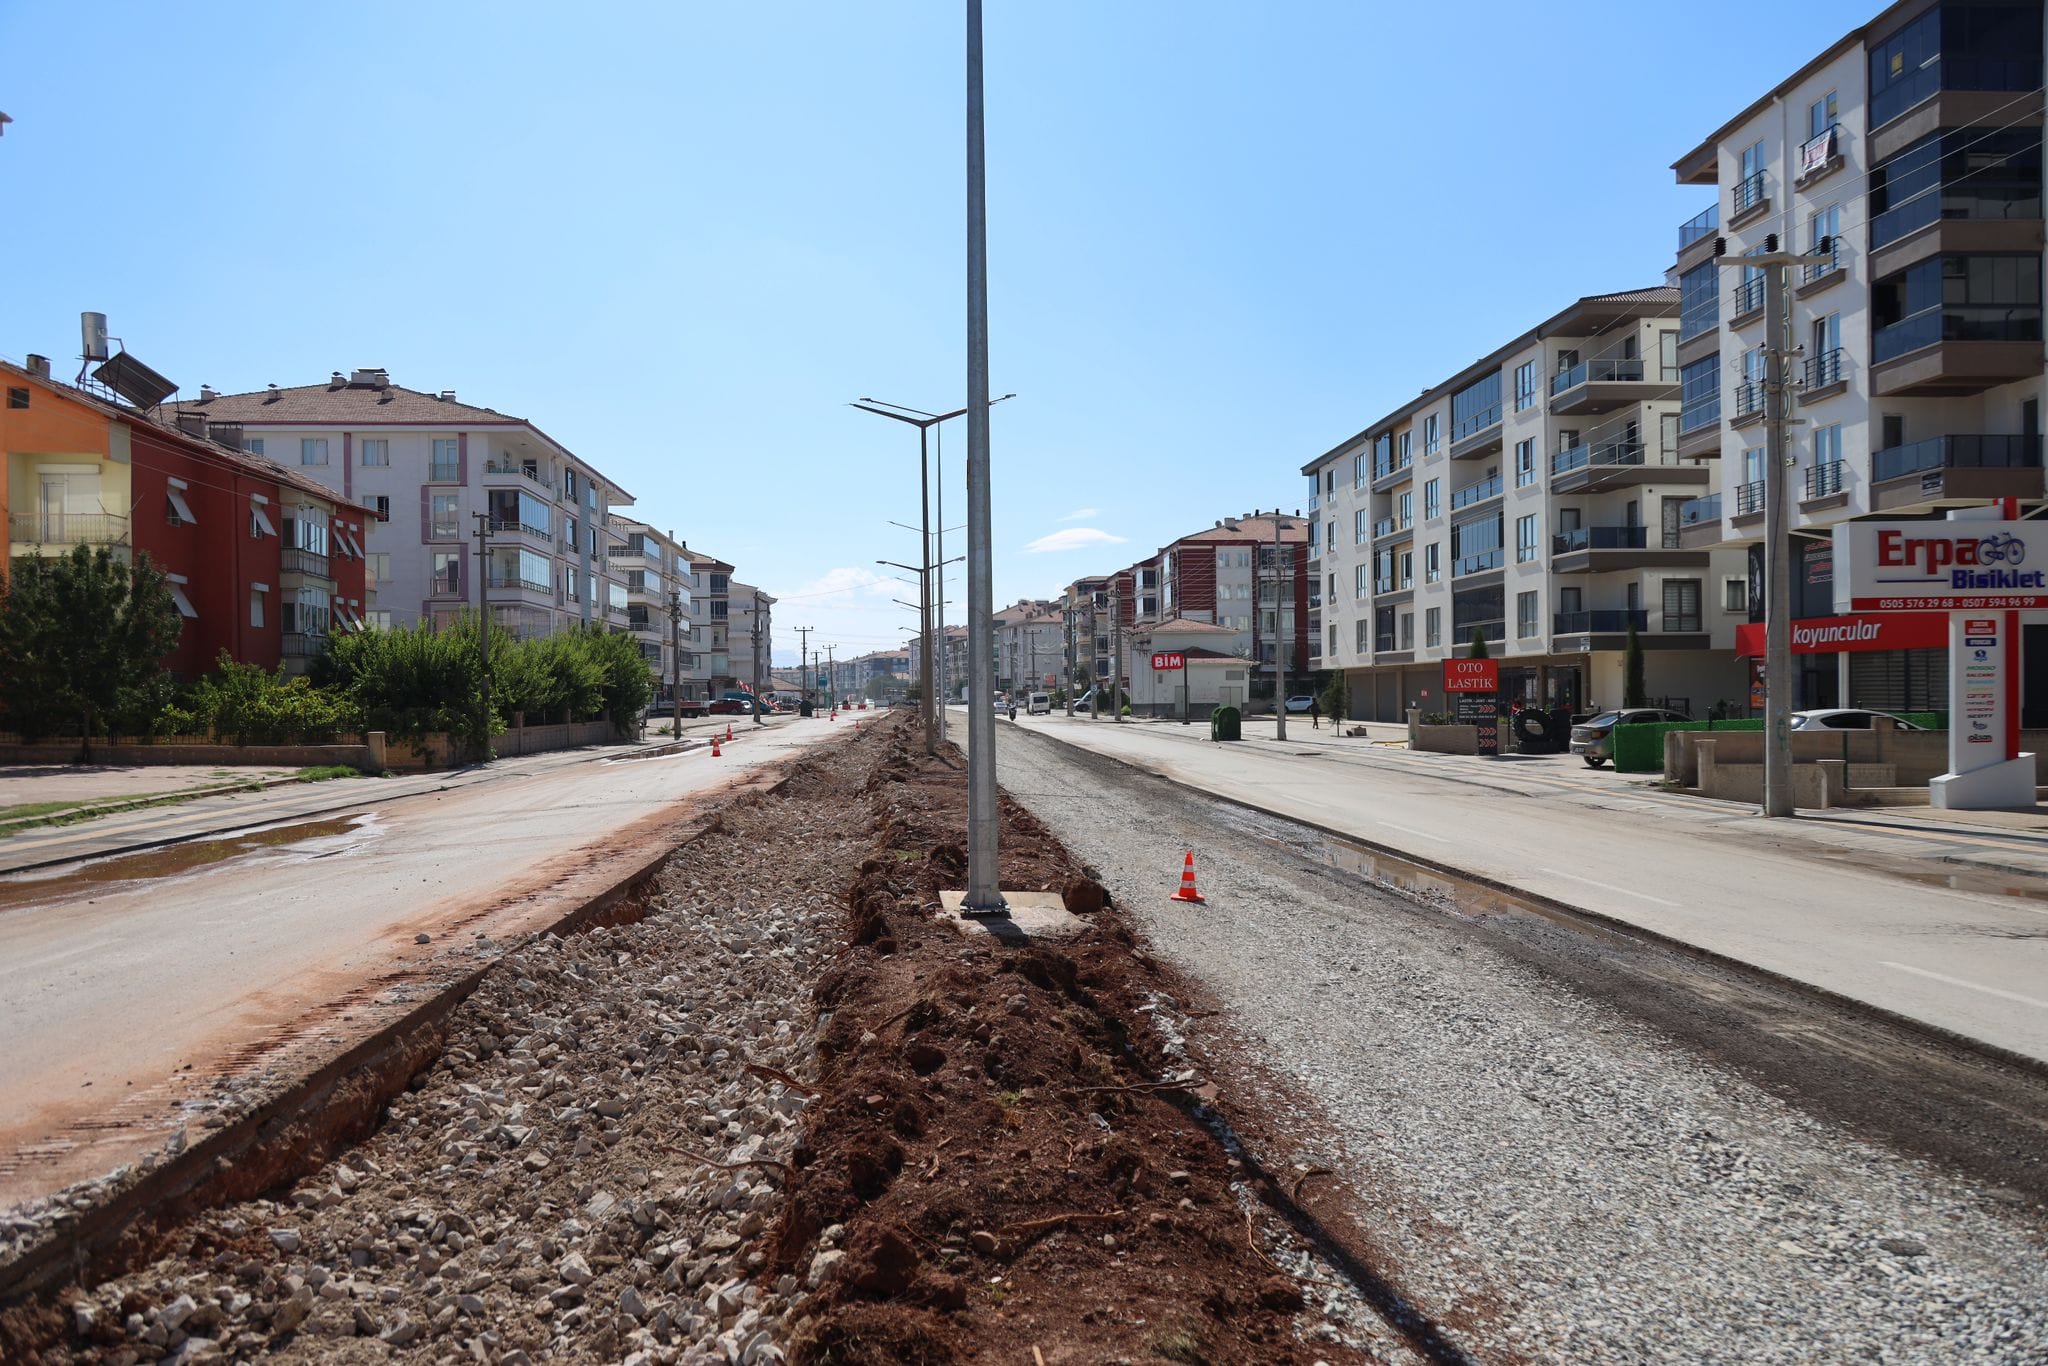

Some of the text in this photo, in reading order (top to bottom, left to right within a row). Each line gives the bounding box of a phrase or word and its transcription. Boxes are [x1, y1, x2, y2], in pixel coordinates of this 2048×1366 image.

[1877, 530, 1980, 575] Erpa
[1951, 569, 2046, 589] Bisiklet
[1880, 600, 1904, 609] 0505
[1907, 600, 1925, 608] 576
[1928, 599, 1939, 608] 29
[1941, 599, 1954, 608] 68
[1962, 598, 1985, 608] 0507
[1988, 598, 2006, 607] 594
[2010, 598, 2022, 606] 96
[2023, 597, 2036, 606] 99
[1792, 619, 1883, 648] koyuncular
[1155, 654, 1181, 667] BİM
[1457, 663, 1483, 672] OTO
[1448, 676, 1493, 688] LASTİK
